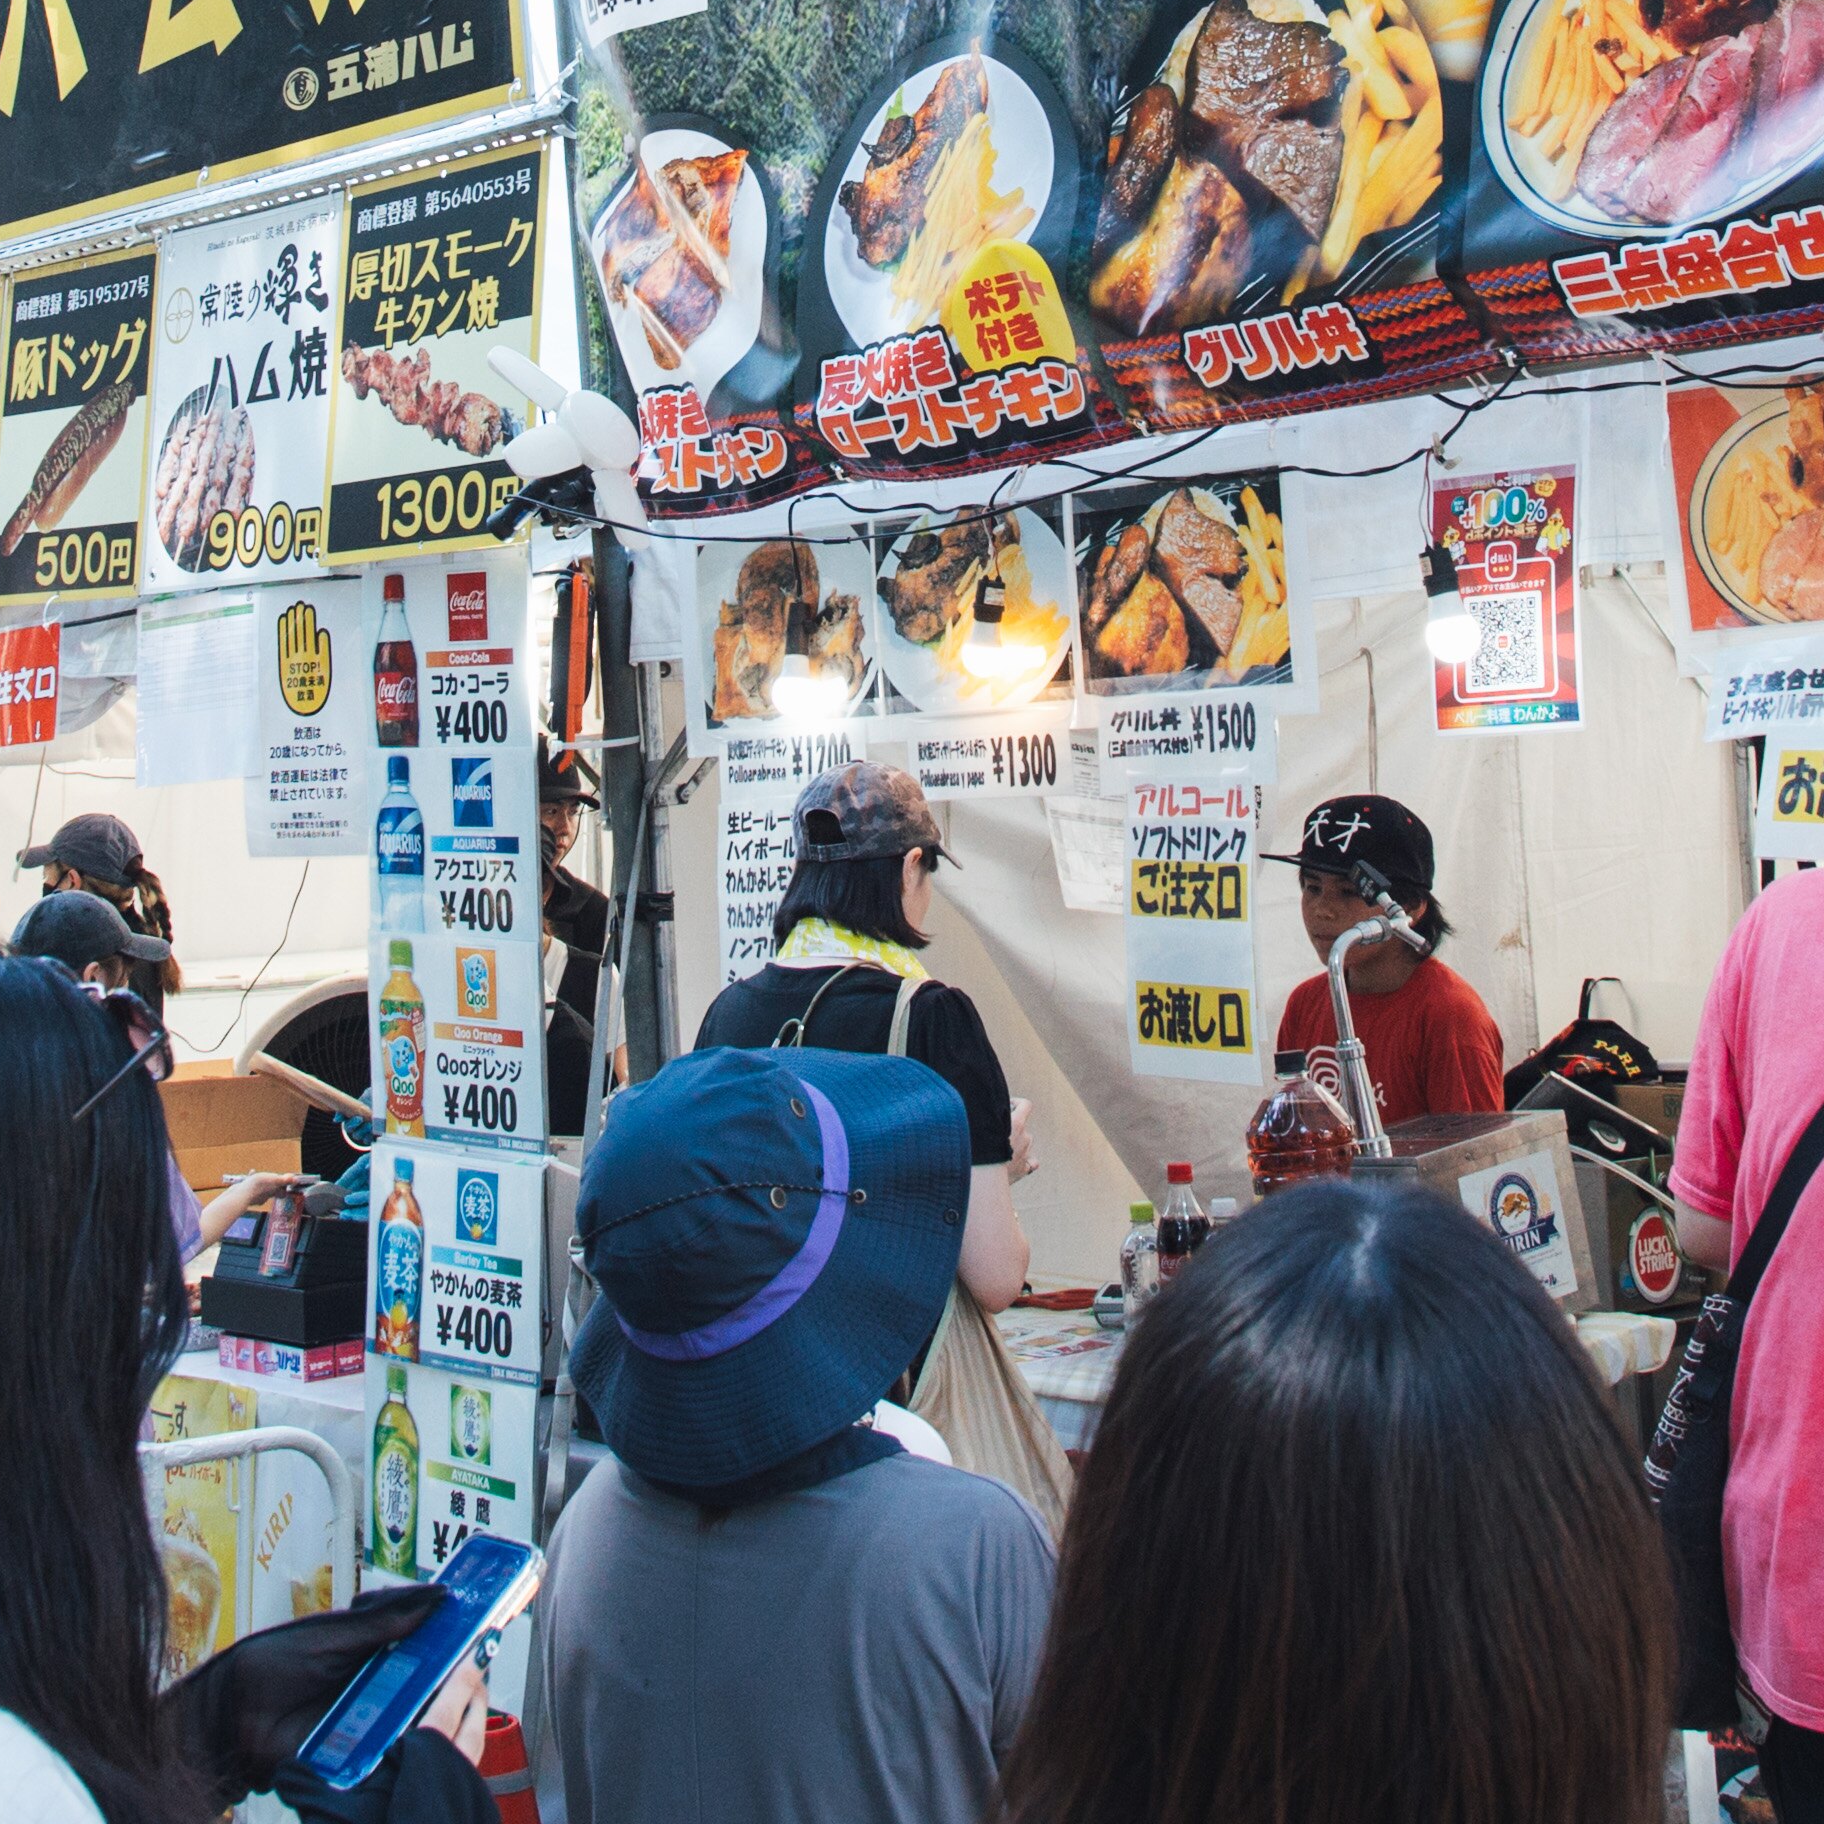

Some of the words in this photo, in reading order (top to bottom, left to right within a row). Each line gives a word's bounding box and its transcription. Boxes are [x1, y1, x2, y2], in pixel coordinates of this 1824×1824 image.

[327, 22, 475, 102] 五浦ハム
[356, 195, 418, 235] 商標登録
[424, 167, 532, 218] 第5640553号
[348, 217, 534, 304] 厚切スモーク
[16, 293, 63, 323] 商標登録
[67, 274, 150, 311] 第5195327号
[200, 243, 329, 327] 常陸の輝き
[964, 270, 1044, 318] ポテト
[374, 275, 500, 351] 牛タン焼
[976, 313, 1044, 363] 付き
[1183, 301, 1369, 388] グリル丼
[10, 316, 147, 403] 豚ドッグ
[204, 326, 328, 414] ハム焼
[820, 331, 957, 409] 炭火焼き
[817, 364, 1086, 459] ローストチキン
[377, 469, 520, 541] 1300円
[1460, 487, 1547, 529] +100%
[208, 500, 322, 570] 900円
[35, 531, 132, 587] 500円
[290, 662, 321, 674] STOP!
[449, 652, 490, 664] Coca-Cola
[287, 676, 325, 688] 20歳未満
[297, 690, 315, 702] 飲酒
[431, 672, 509, 695] コカ・コーラ
[294, 727, 321, 740] 飲酒は
[435, 700, 508, 743] ¥400
[1111, 708, 1181, 733] グリル丼
[1191, 702, 1256, 752] ¥1500
[1454, 708, 1510, 724] ペルー料理
[1514, 705, 1560, 721] わんかよ
[271, 768, 348, 783] 飲酒運転は法律で
[991, 733, 1057, 787] ¥1300
[453, 785, 492, 801] AQUARIUS
[1135, 783, 1250, 818] アルコール
[379, 833, 422, 855] AQUARIUS
[452, 838, 496, 851] AQUARIUS
[727, 836, 795, 861] ハイボール
[1132, 826, 1247, 862] ソフトドリンク
[1303, 808, 1371, 853] 天才
[434, 858, 517, 882] アクエリアス
[1136, 861, 1242, 920] ご注文口
[440, 888, 513, 932] ¥400
[466, 990, 487, 1007] Qoo
[1139, 987, 1246, 1047] お渡し口
[473, 1028, 503, 1044] Orange
[392, 1078, 415, 1095] Qoo
[437, 1052, 522, 1083] Qooオレンジ
[444, 1083, 517, 1133] ¥400
[464, 1195, 491, 1219] 麦茶
[383, 1252, 419, 1292] 麦茶
[1639, 1253, 1675, 1274] STRIKE
[430, 1269, 522, 1309] やかんの麦茶
[437, 1304, 512, 1359] ¥400
[451, 1469, 490, 1490] AYATAKA
